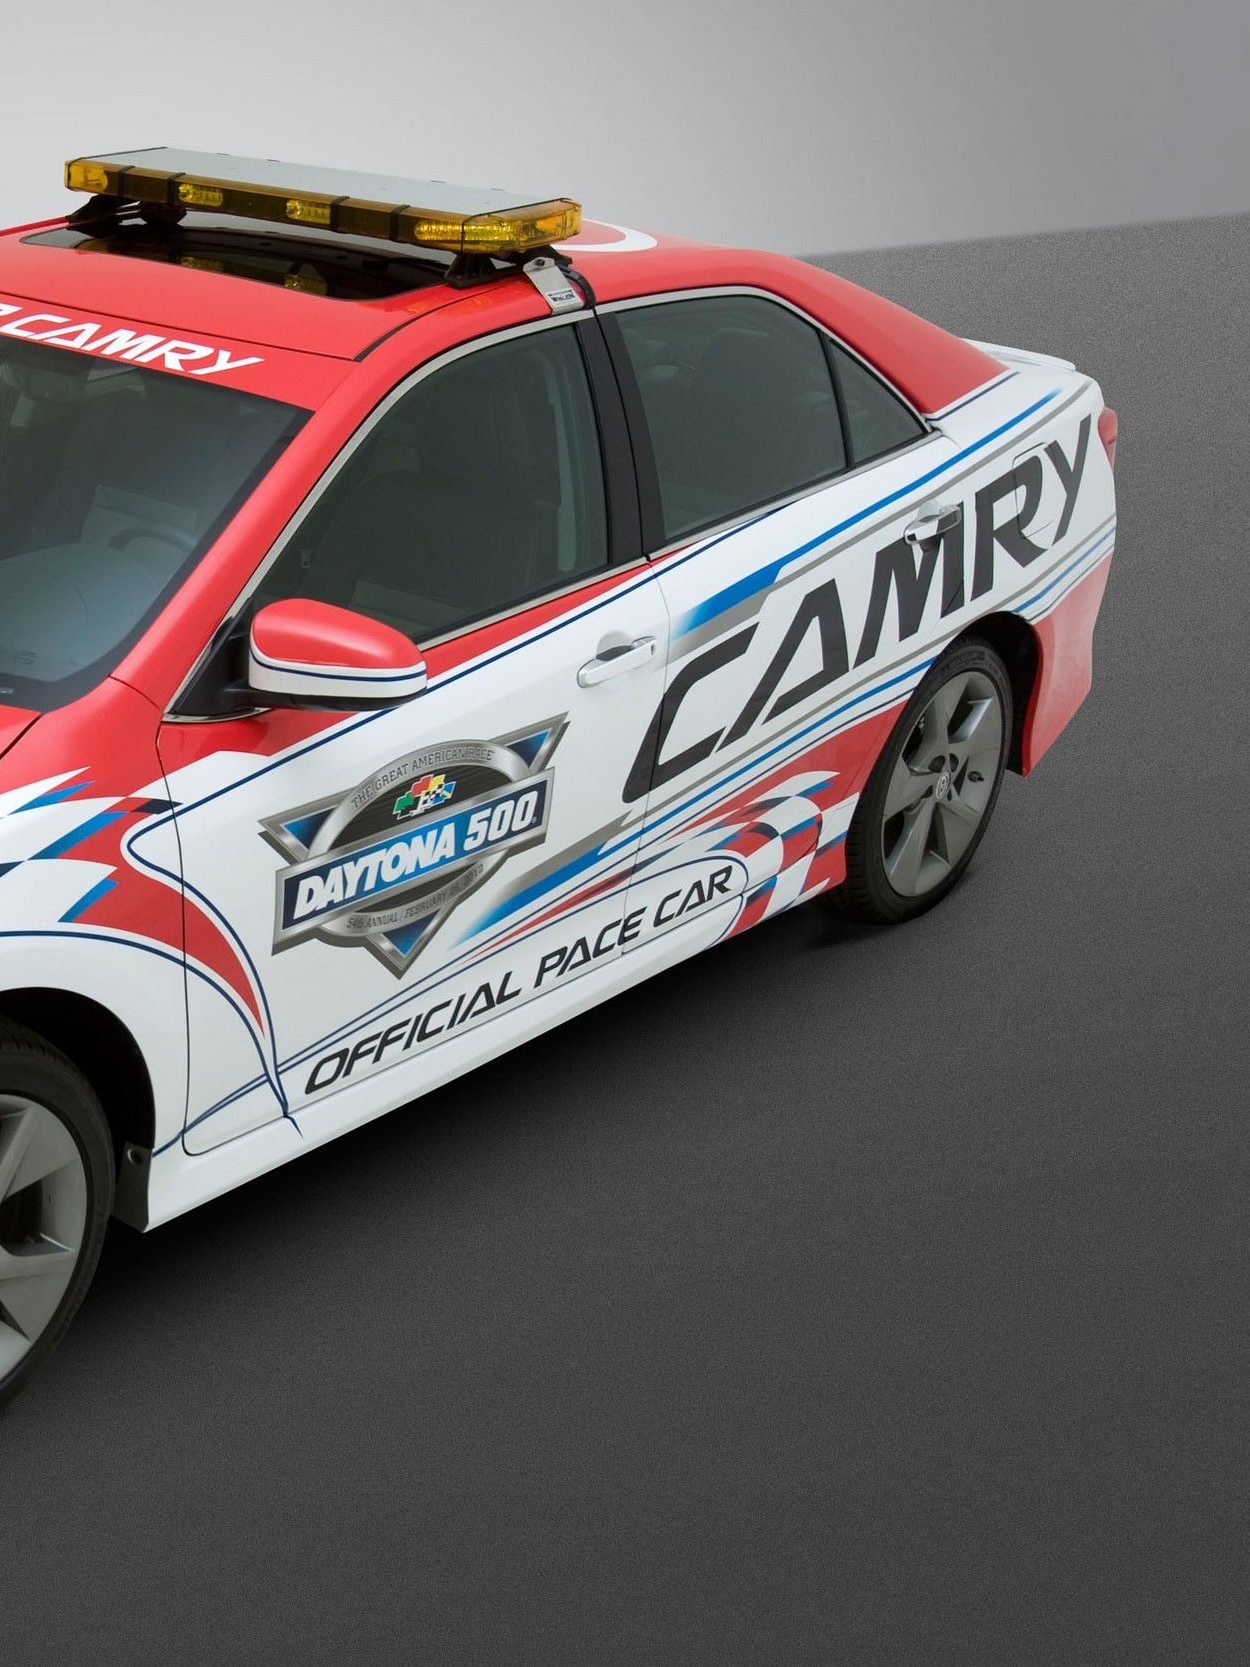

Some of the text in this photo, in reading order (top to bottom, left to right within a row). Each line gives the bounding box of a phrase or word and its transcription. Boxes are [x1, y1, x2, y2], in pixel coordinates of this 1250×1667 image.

[622, 413, 1091, 804] CAMRY
[351, 747, 494, 808] THE GREAT AMERICAN RACE
[293, 822, 455, 920] DAYTONA
[364, 912, 399, 928] ANNUAL
[404, 892, 447, 918] FEBRUARY
[305, 865, 733, 1095] OFFICIAL PACE CAR
